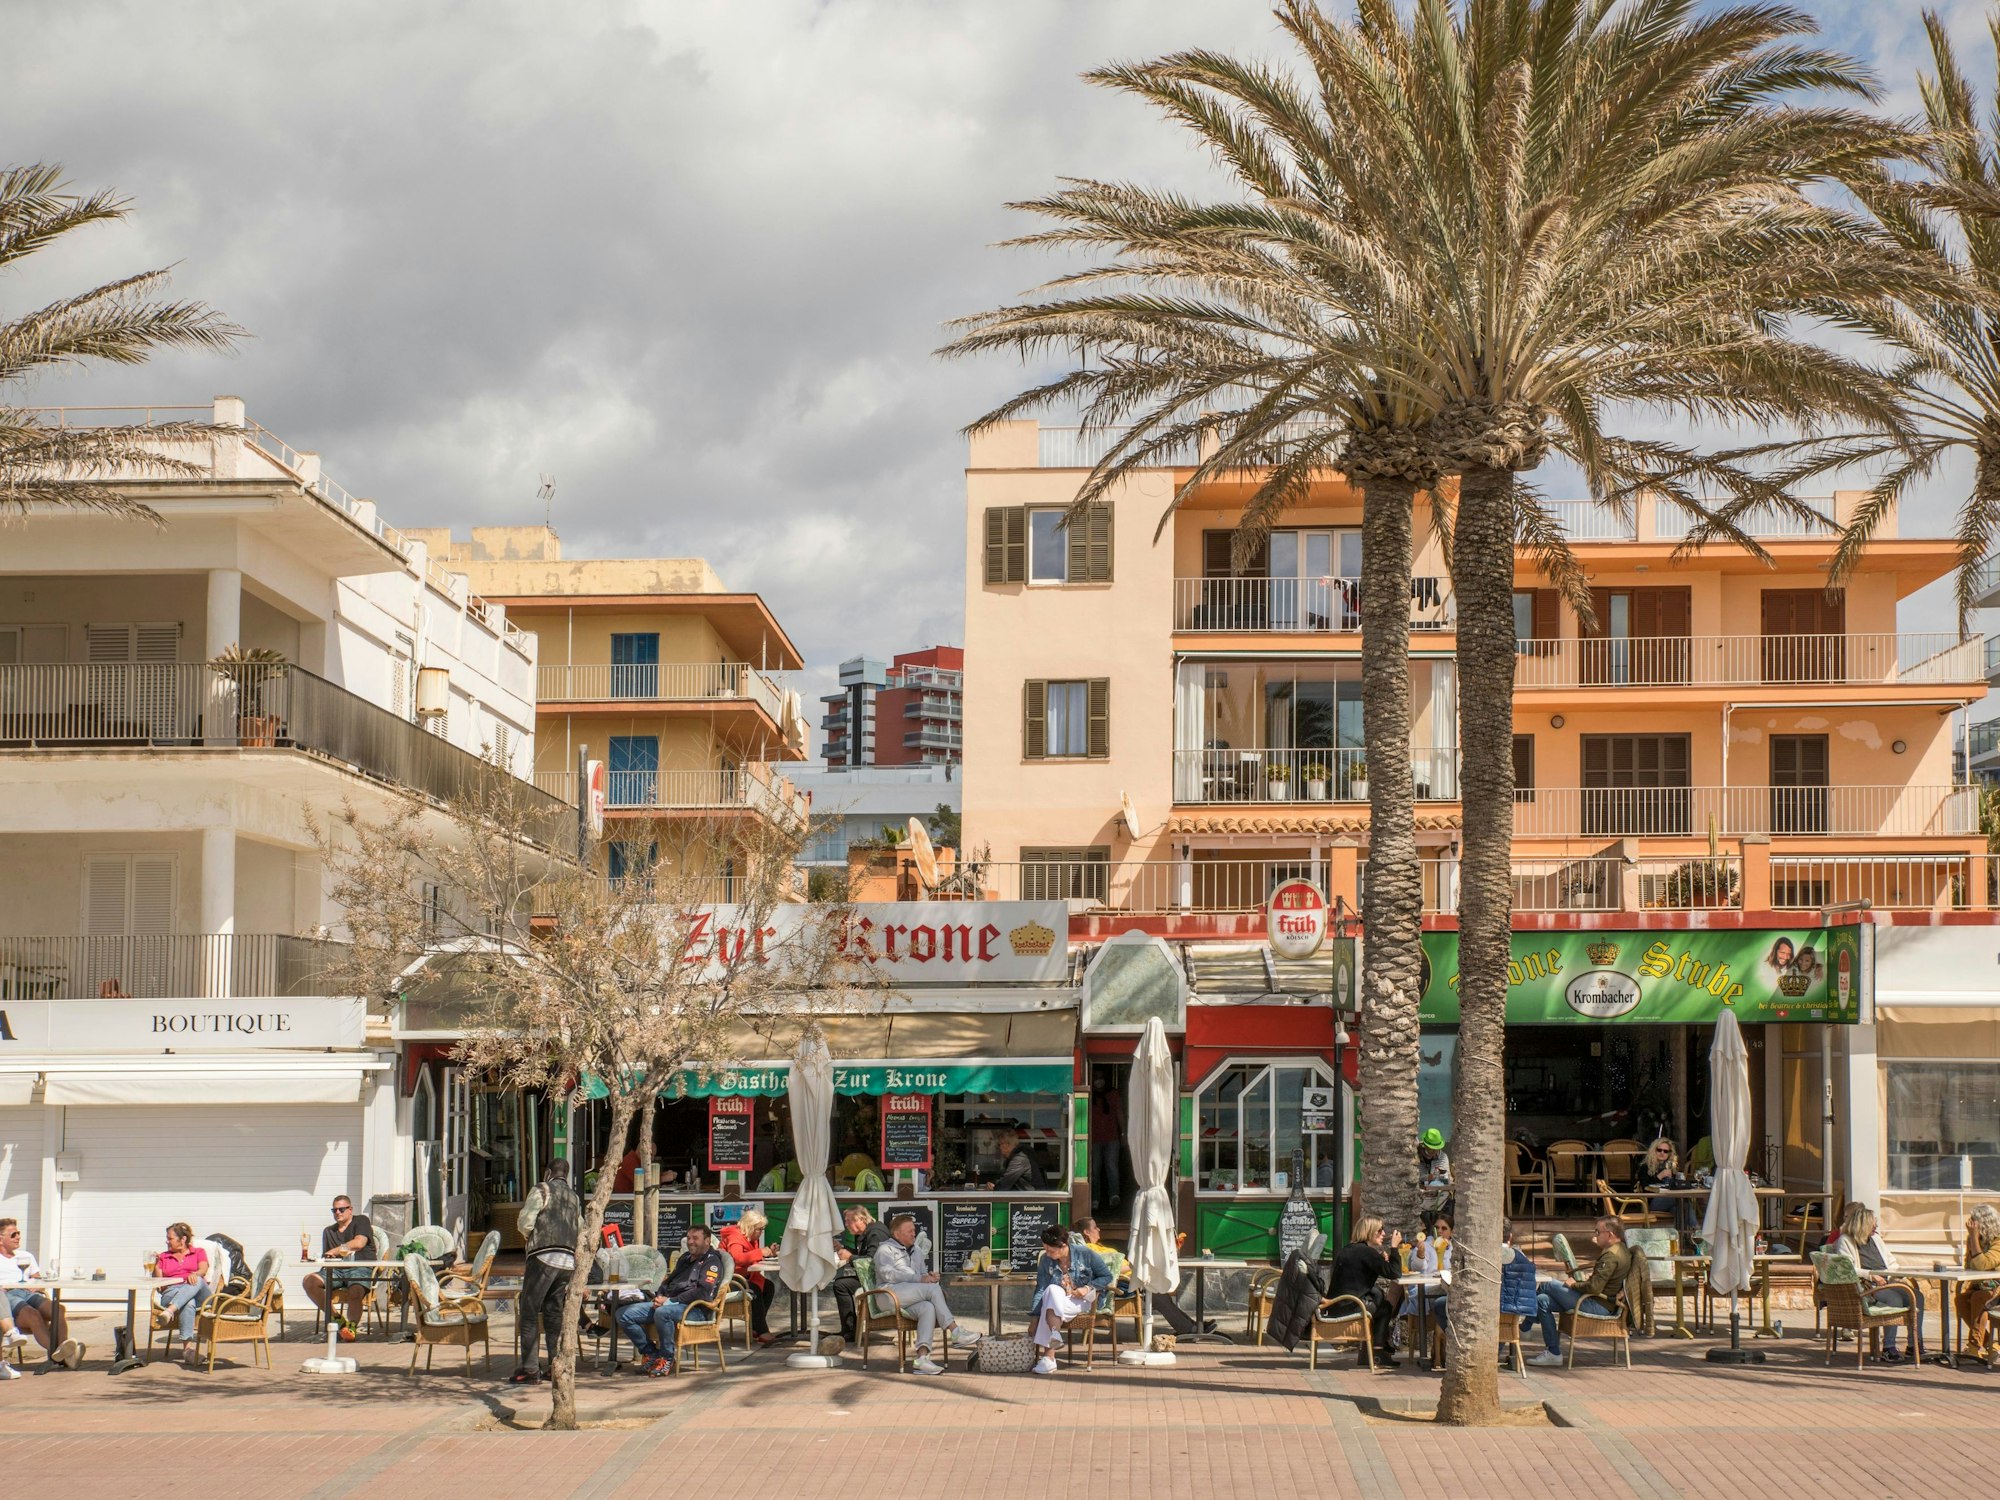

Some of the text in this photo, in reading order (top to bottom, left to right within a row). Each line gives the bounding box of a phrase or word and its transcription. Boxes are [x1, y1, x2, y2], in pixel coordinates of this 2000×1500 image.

[1278, 914, 1316, 935] früh
[678, 909, 1001, 966] Zur Krone
[1638, 941, 1744, 1005] Stube
[1574, 988, 1635, 1005] Krombacher
[152, 1014, 291, 1034] BOUTIQUE
[719, 1069, 947, 1091] Gastha Zur Krone
[716, 1098, 743, 1113] früh
[890, 1096, 920, 1111] früh
